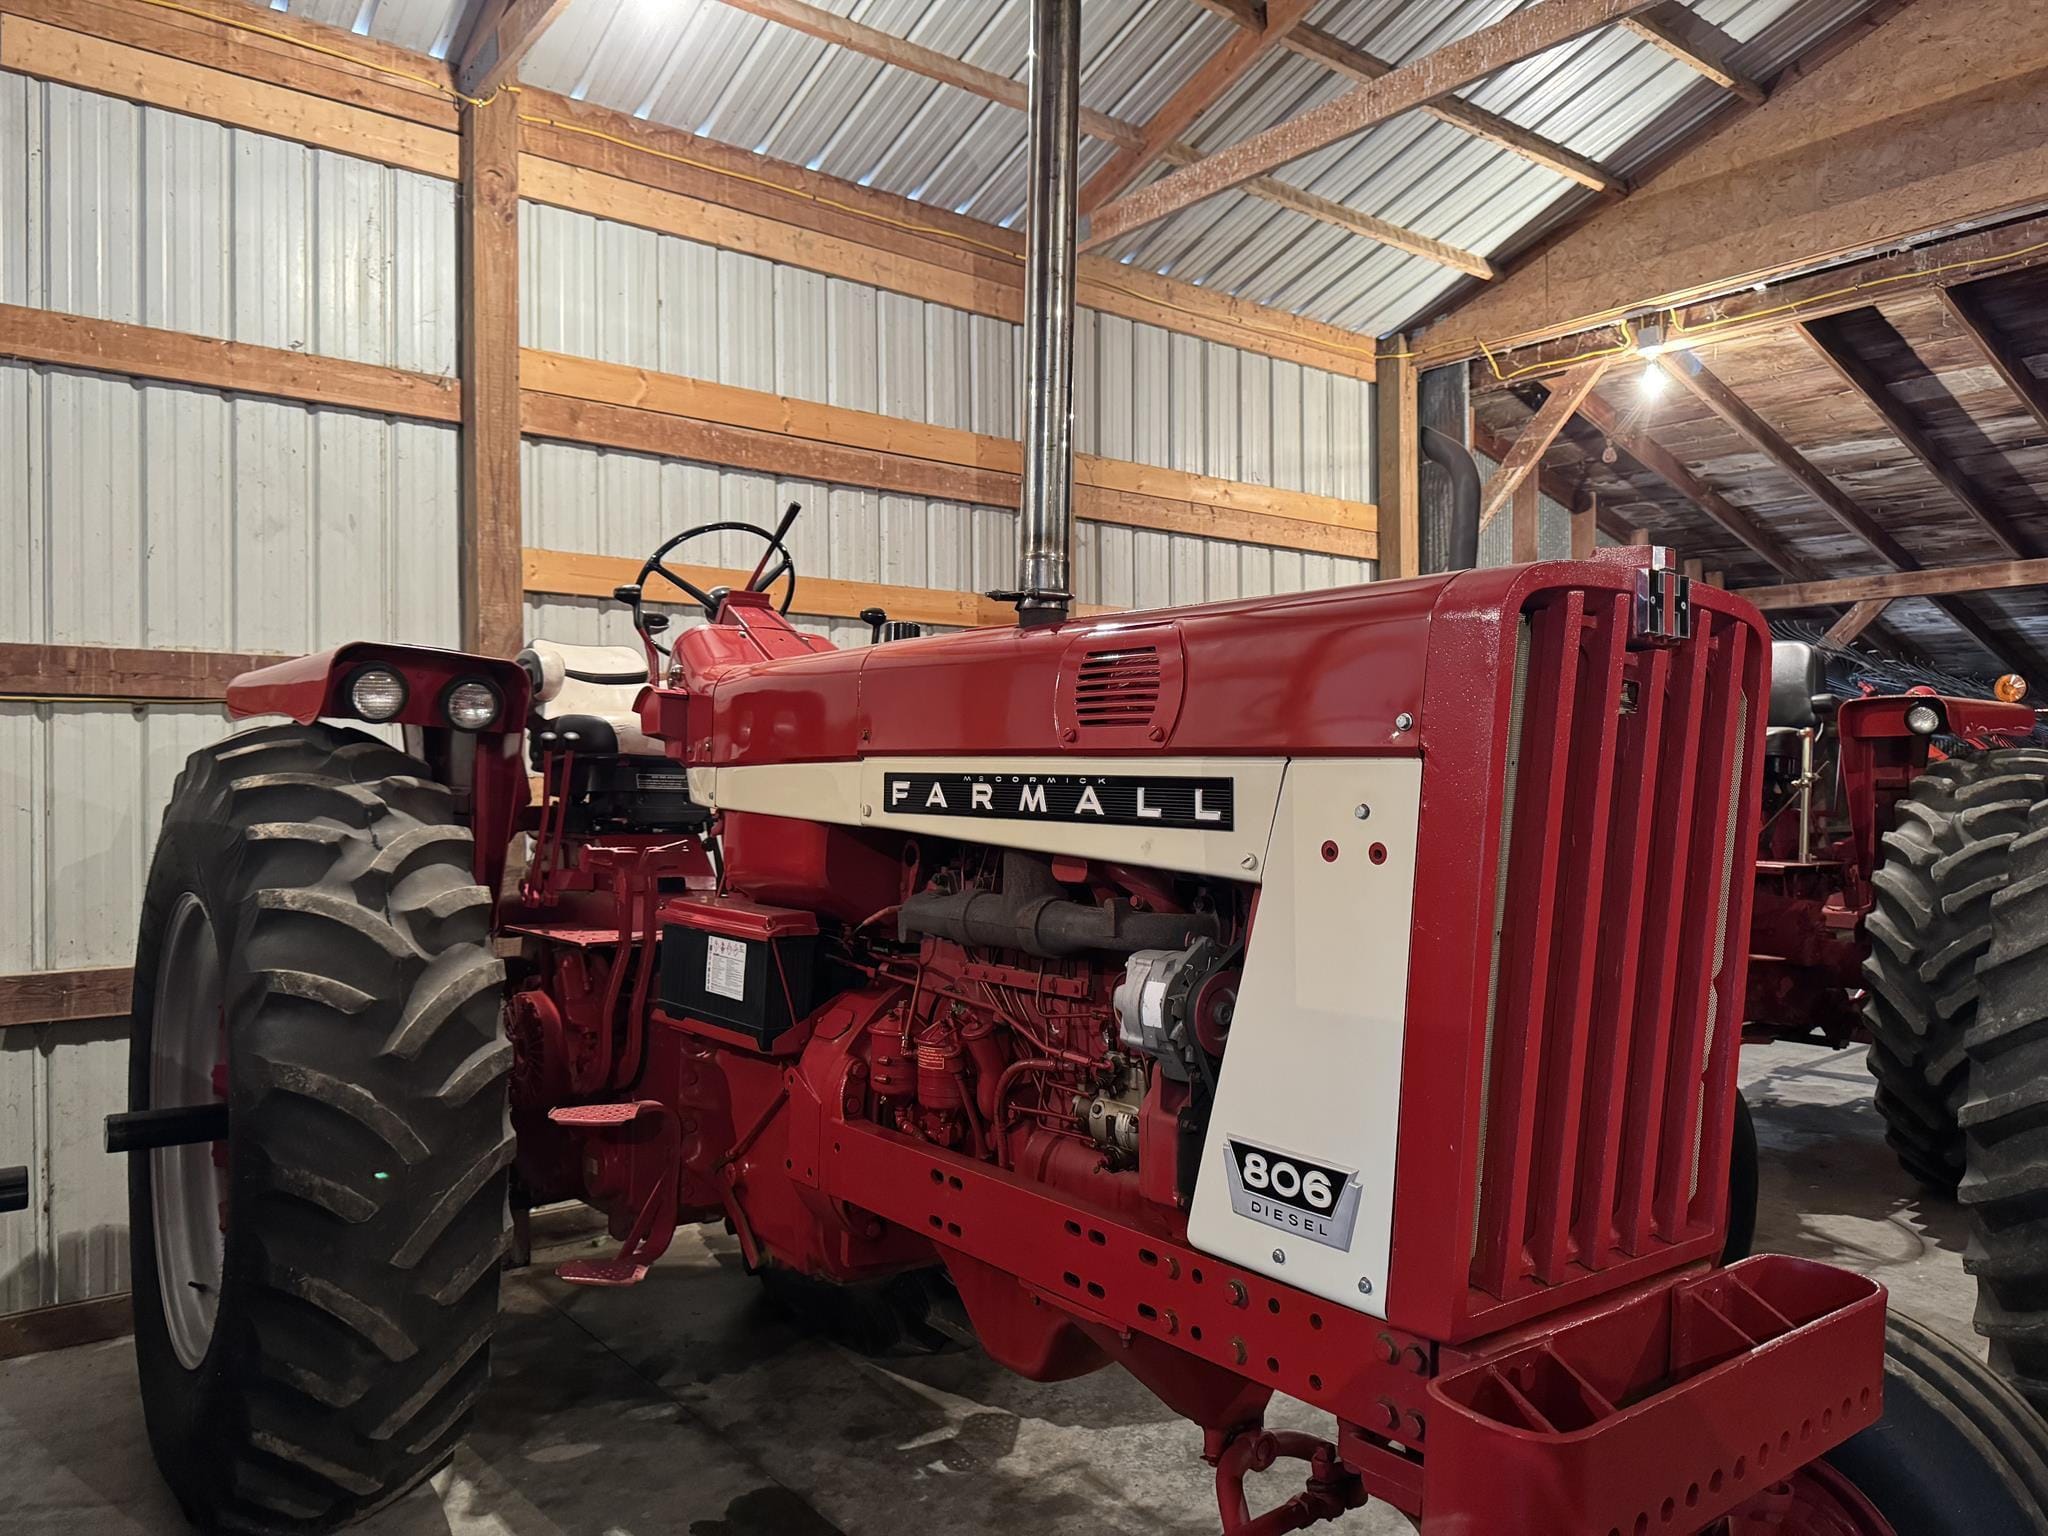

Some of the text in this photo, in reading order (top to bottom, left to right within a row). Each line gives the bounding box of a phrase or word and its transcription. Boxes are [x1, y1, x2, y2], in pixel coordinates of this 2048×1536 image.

[892, 780, 1221, 820] FARMALL
[1243, 1153, 1332, 1208] 806
[1251, 1200, 1328, 1236] DIESEL
